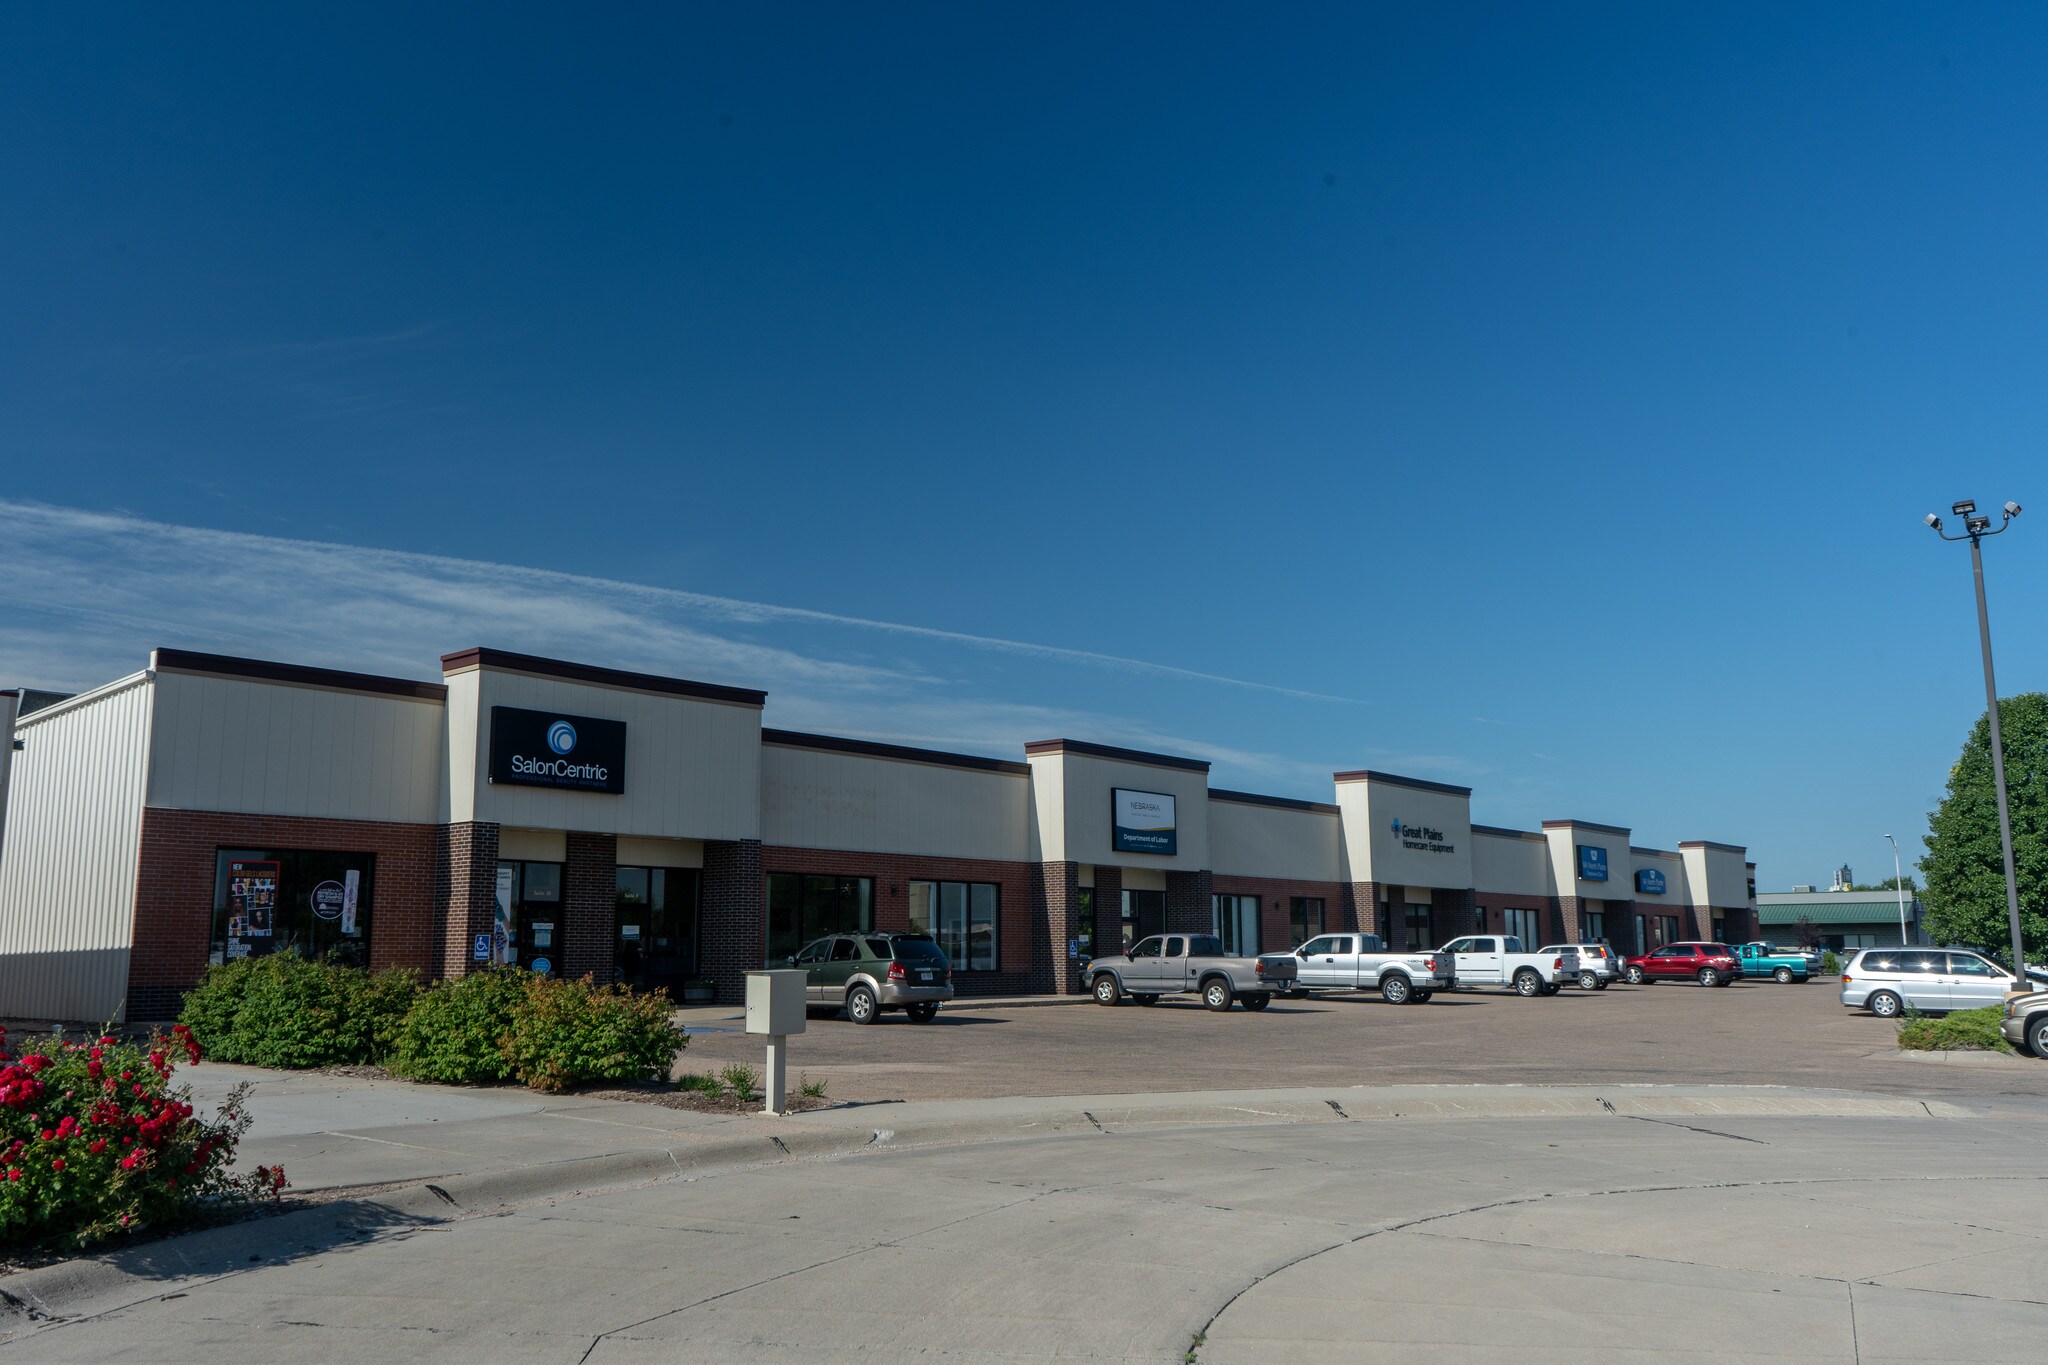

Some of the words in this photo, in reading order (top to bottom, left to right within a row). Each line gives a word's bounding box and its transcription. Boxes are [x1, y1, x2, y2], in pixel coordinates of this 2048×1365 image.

[512, 755, 608, 780] SalonCentric
[1130, 802, 1160, 811] NEBRASKA
[1402, 825, 1422, 839] Great
[1423, 827, 1443, 841] Plains
[1402, 839, 1428, 850] Homecare
[1429, 842, 1454, 854] Equipment
